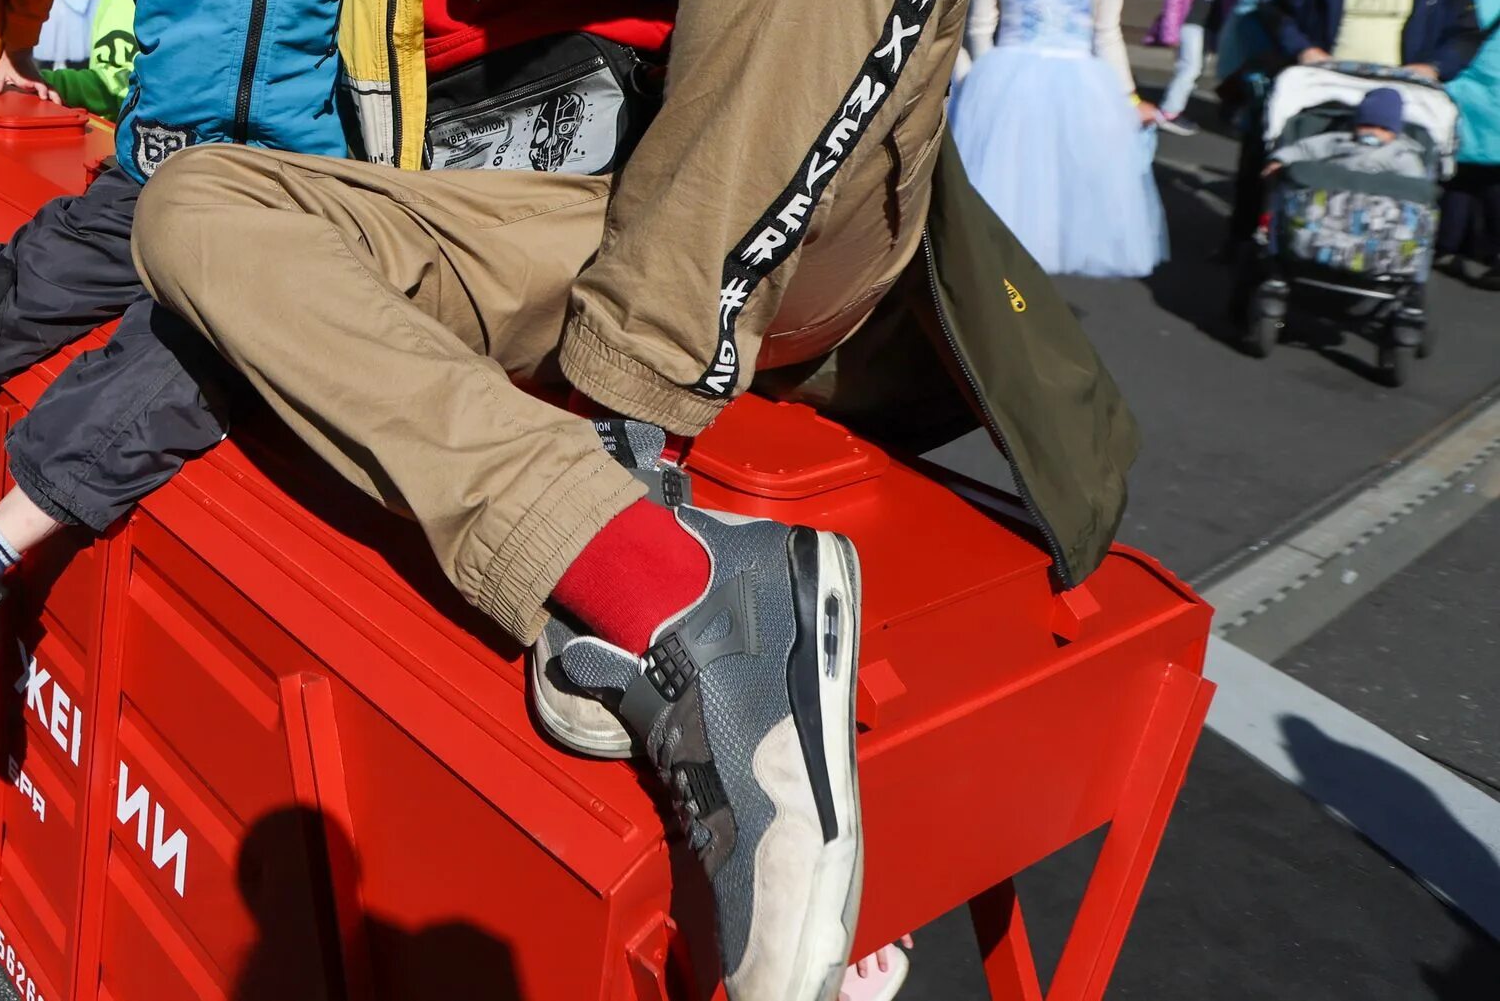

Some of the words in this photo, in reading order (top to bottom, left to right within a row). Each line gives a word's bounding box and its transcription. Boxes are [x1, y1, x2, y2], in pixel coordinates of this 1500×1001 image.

[470, 119, 506, 137] MOTION
[740, 75, 886, 268] NEVER
[700, 340, 736, 395] GIV
